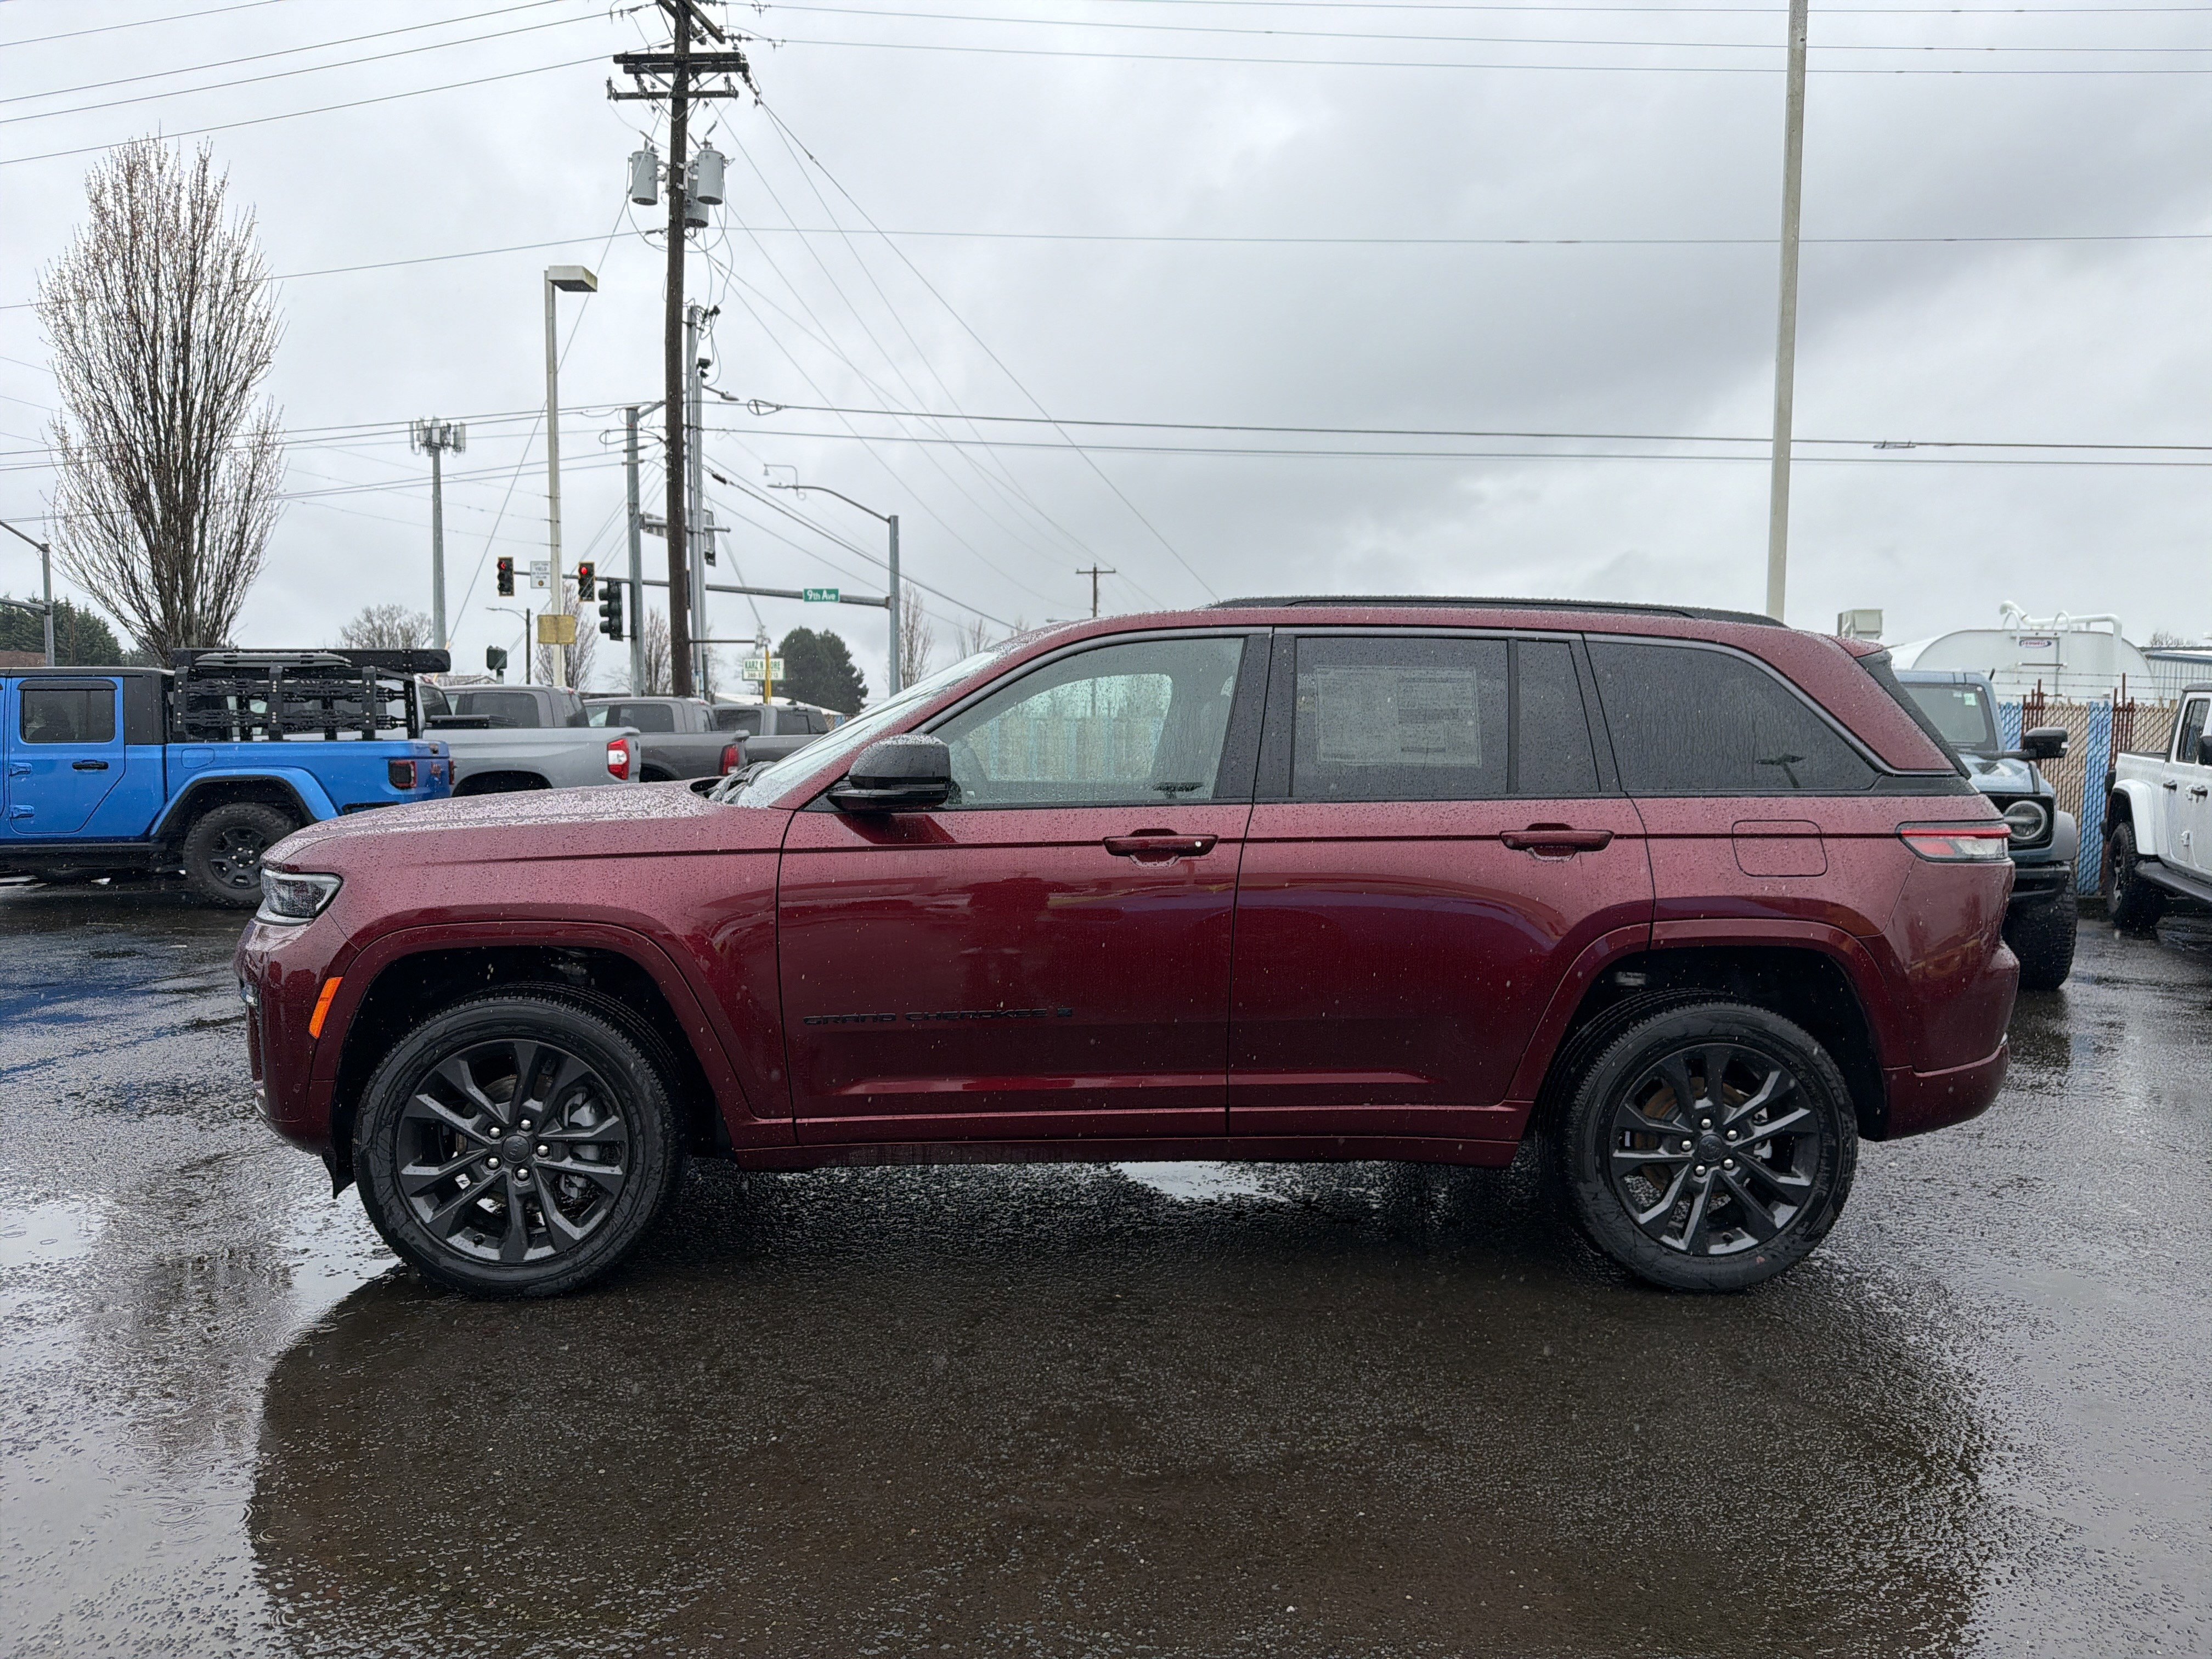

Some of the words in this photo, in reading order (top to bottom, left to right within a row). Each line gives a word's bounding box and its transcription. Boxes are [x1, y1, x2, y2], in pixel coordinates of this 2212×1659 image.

[807, 589, 820, 600] 9th
[822, 589, 836, 600] Ave
[803, 1012, 896, 1025] GRAND
[905, 1008, 1048, 1021] CHEROKEE
